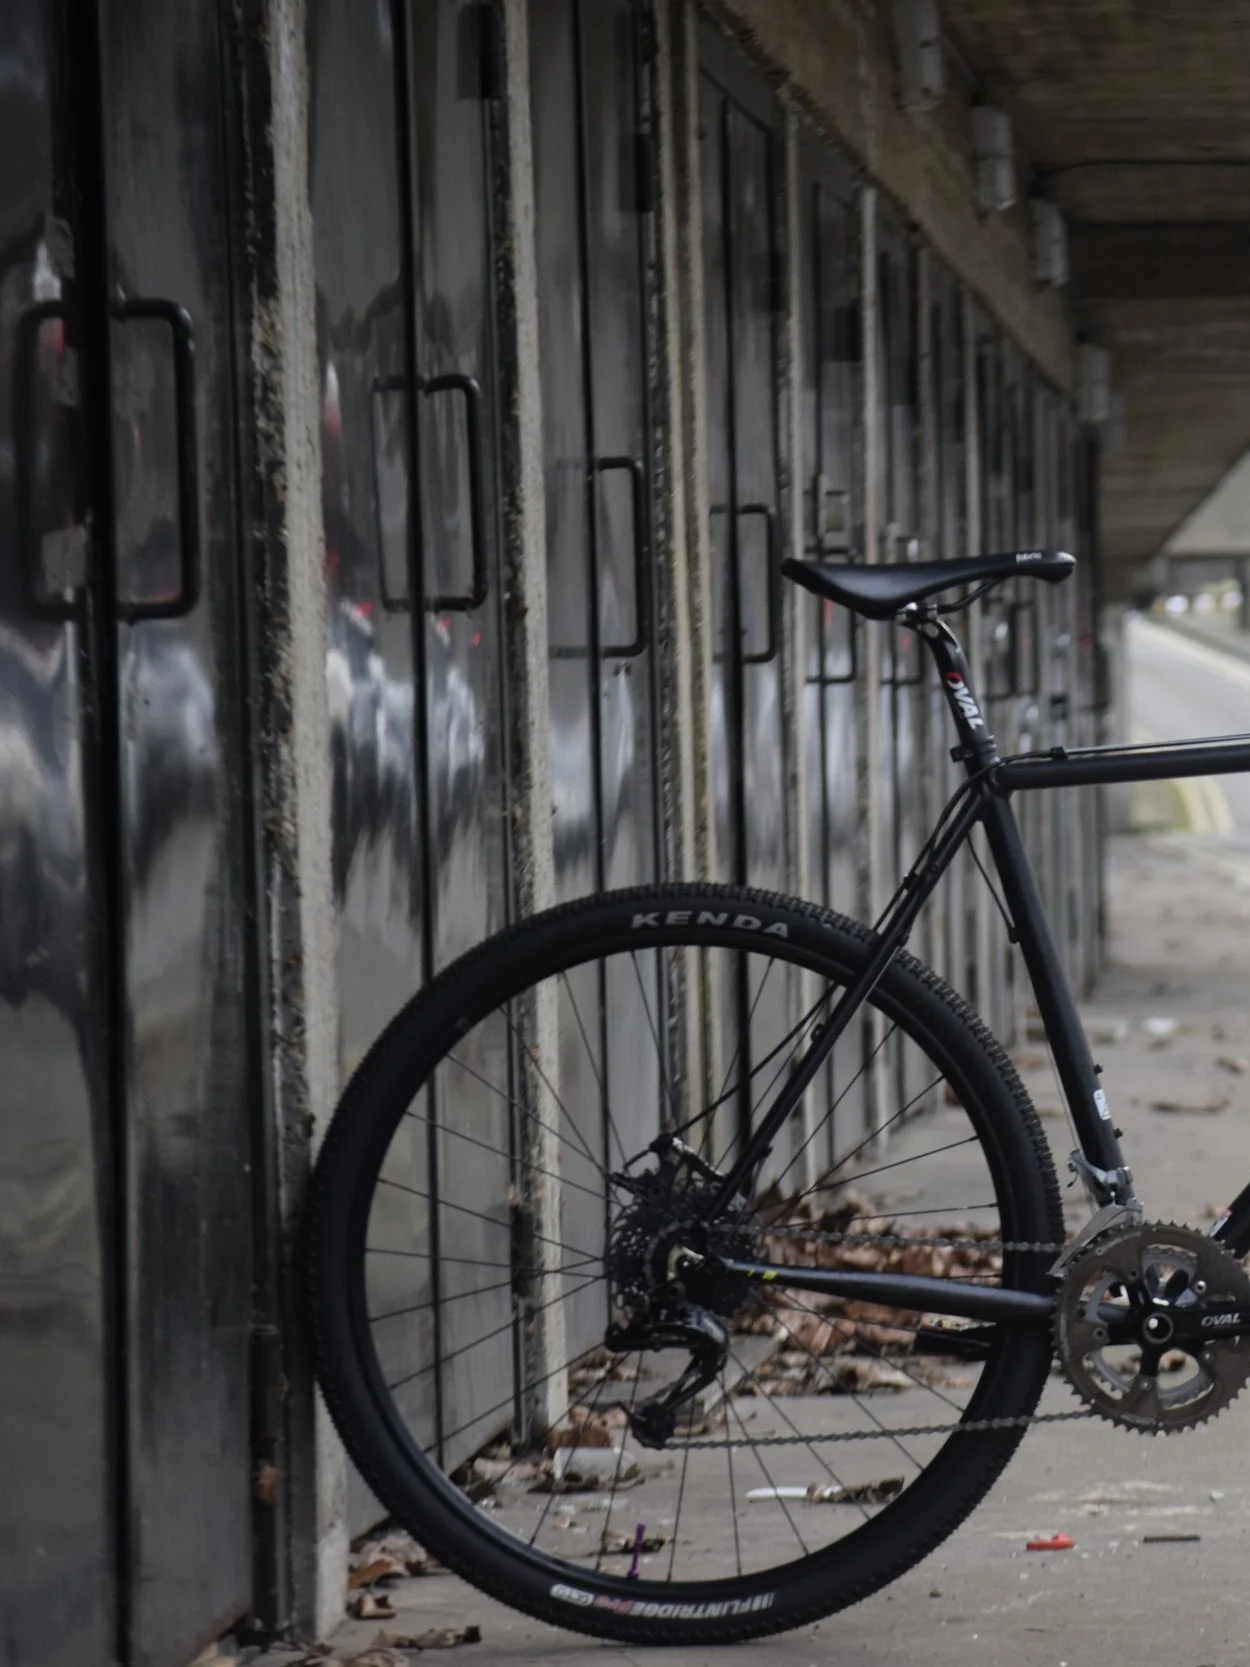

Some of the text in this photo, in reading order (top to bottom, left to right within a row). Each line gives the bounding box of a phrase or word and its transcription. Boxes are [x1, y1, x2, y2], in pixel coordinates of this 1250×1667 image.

[944, 672, 984, 730] OVAL
[631, 910, 789, 938] KENDA
[1201, 1312, 1241, 1327] OVAL
